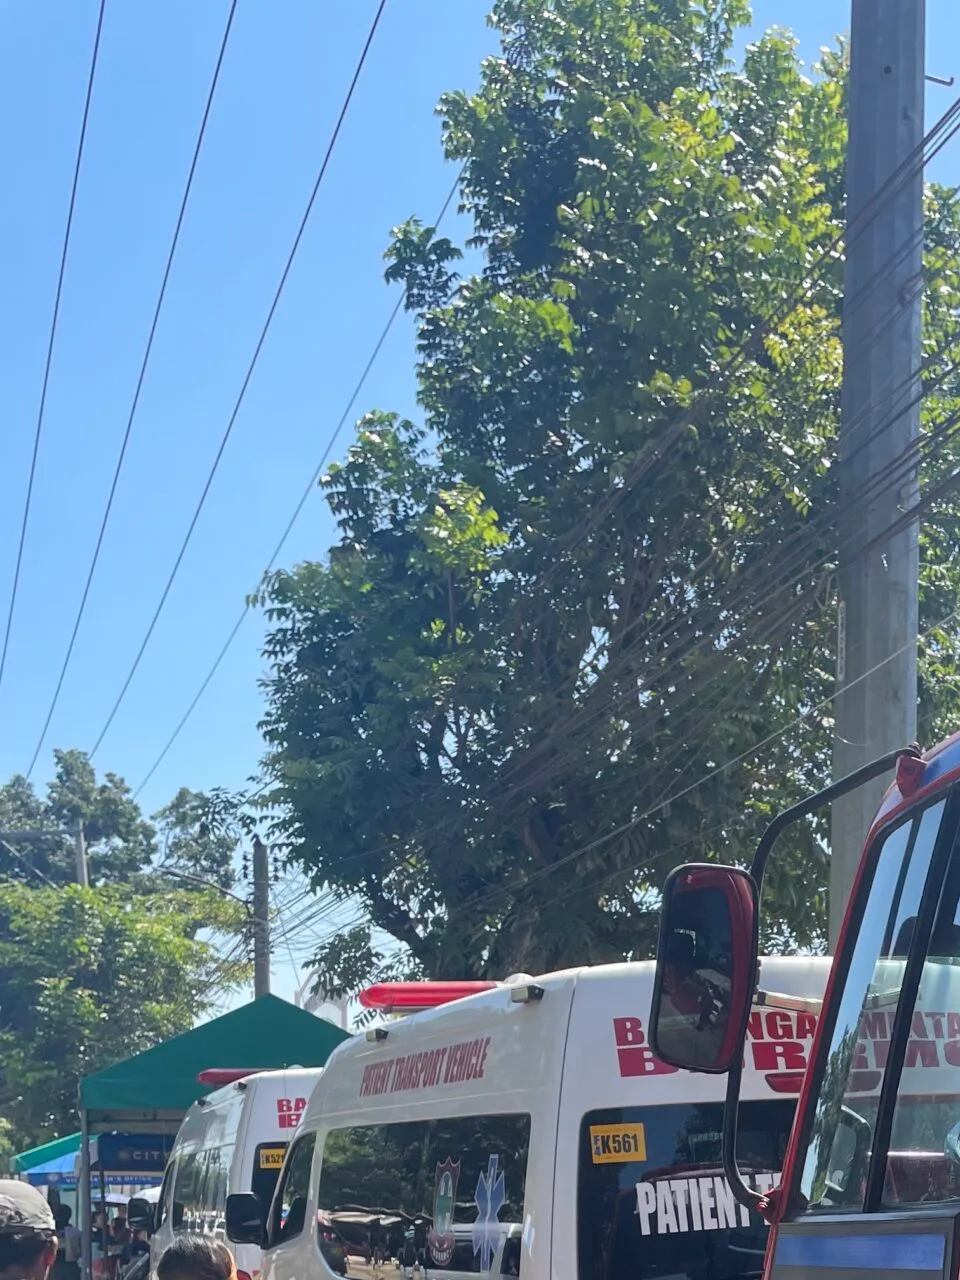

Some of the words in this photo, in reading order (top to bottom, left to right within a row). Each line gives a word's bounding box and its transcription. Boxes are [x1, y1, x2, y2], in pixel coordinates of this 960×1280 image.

[390, 1047, 448, 1092] TRANSPORT
[443, 1037, 491, 1084] VEHICLE
[601, 1133, 639, 1154] K561
